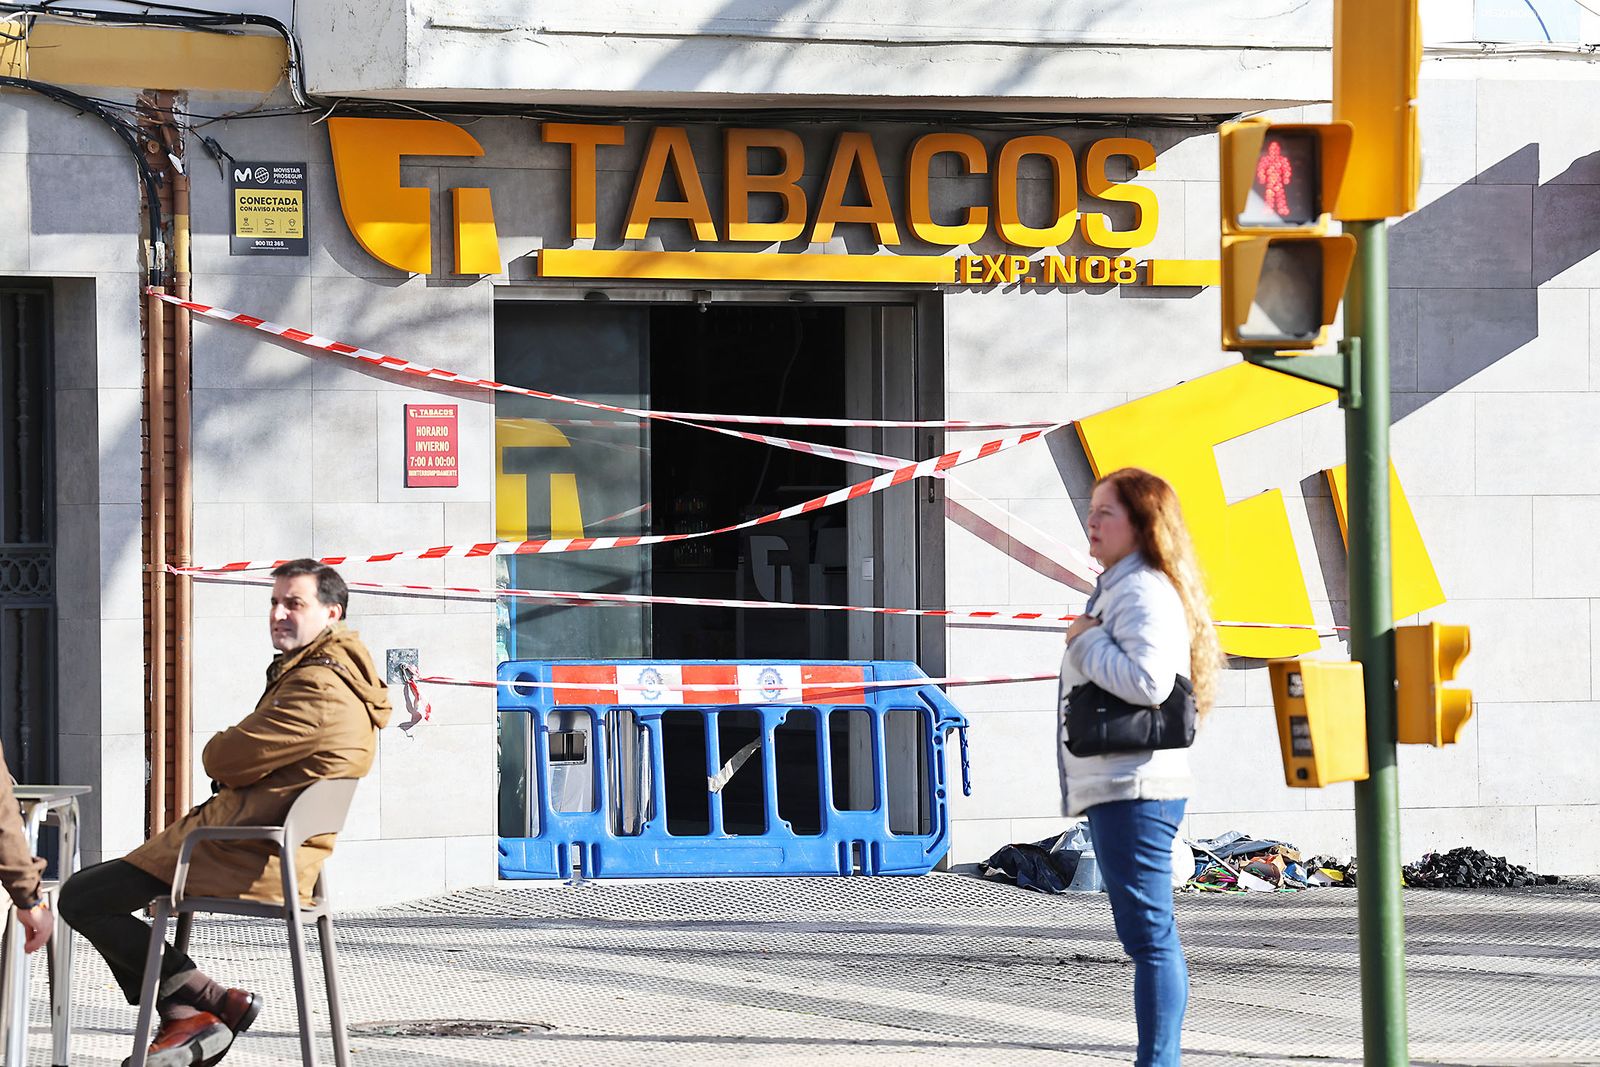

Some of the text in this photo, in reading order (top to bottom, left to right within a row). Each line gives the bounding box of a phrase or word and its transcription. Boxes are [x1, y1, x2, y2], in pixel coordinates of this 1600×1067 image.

[542, 123, 1160, 249] TABACOS
[240, 197, 298, 205] CONECTADA
[962, 254, 1037, 285] EXP.
[416, 426, 449, 437] HORARIO
[415, 441, 450, 452] INVIERNO
[410, 456, 456, 467] 7:00 A 00:00
